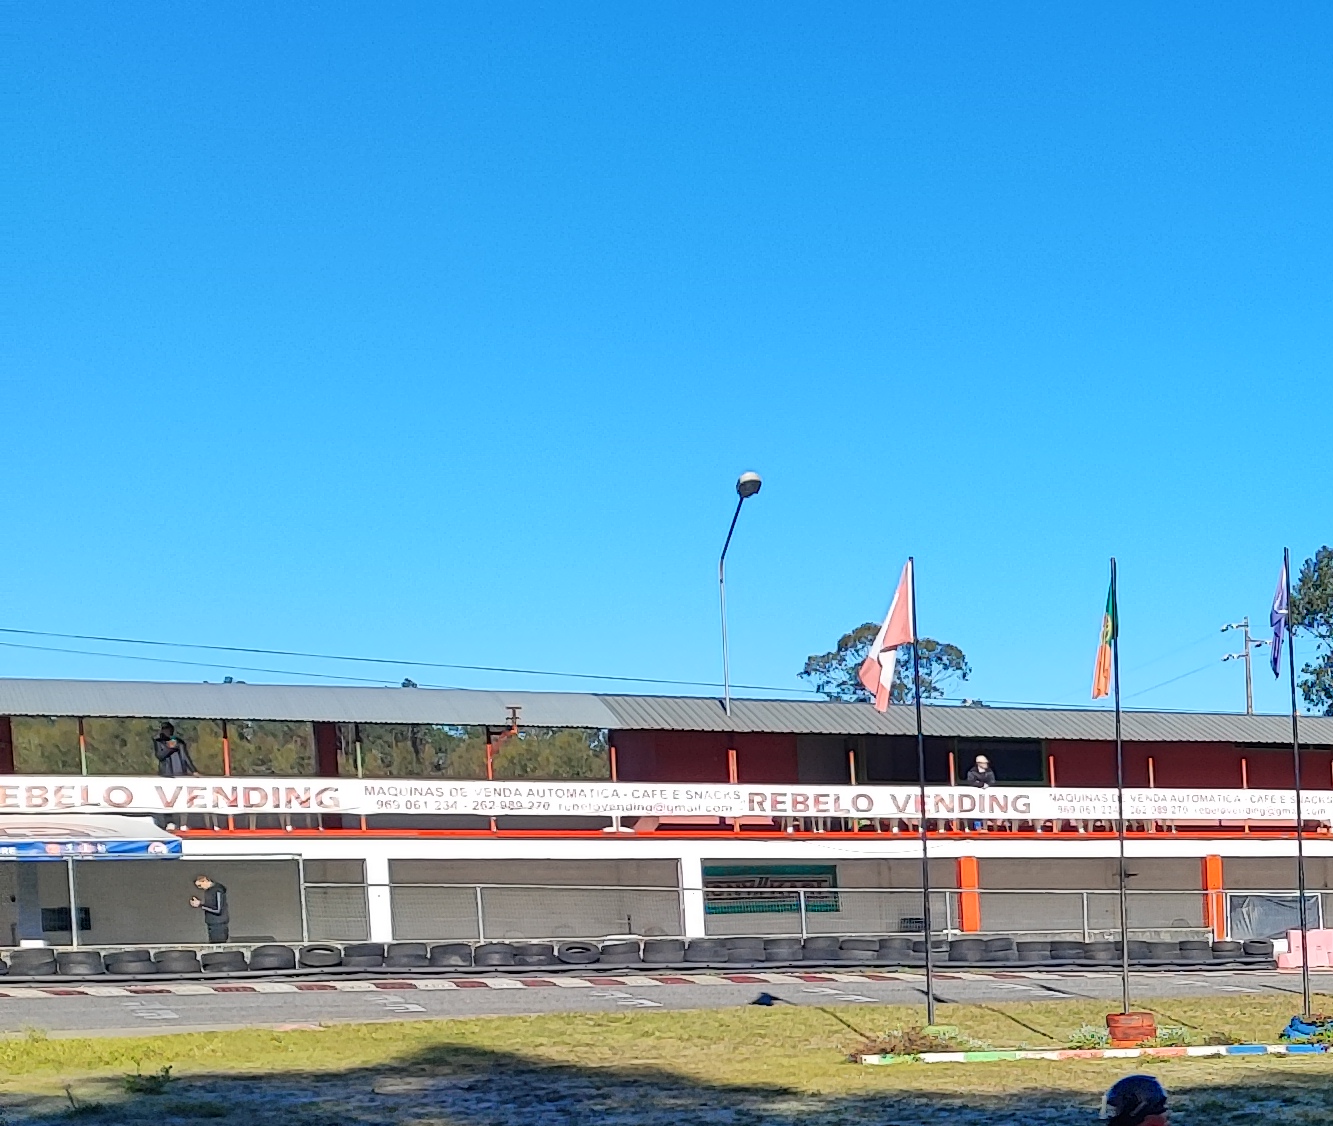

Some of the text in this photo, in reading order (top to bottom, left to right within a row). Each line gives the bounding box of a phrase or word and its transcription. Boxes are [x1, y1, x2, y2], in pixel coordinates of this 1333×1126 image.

[154, 785, 341, 809] VENDING
[685, 790, 741, 800] SNACKS
[747, 792, 1031, 814] REBELO VENDING
